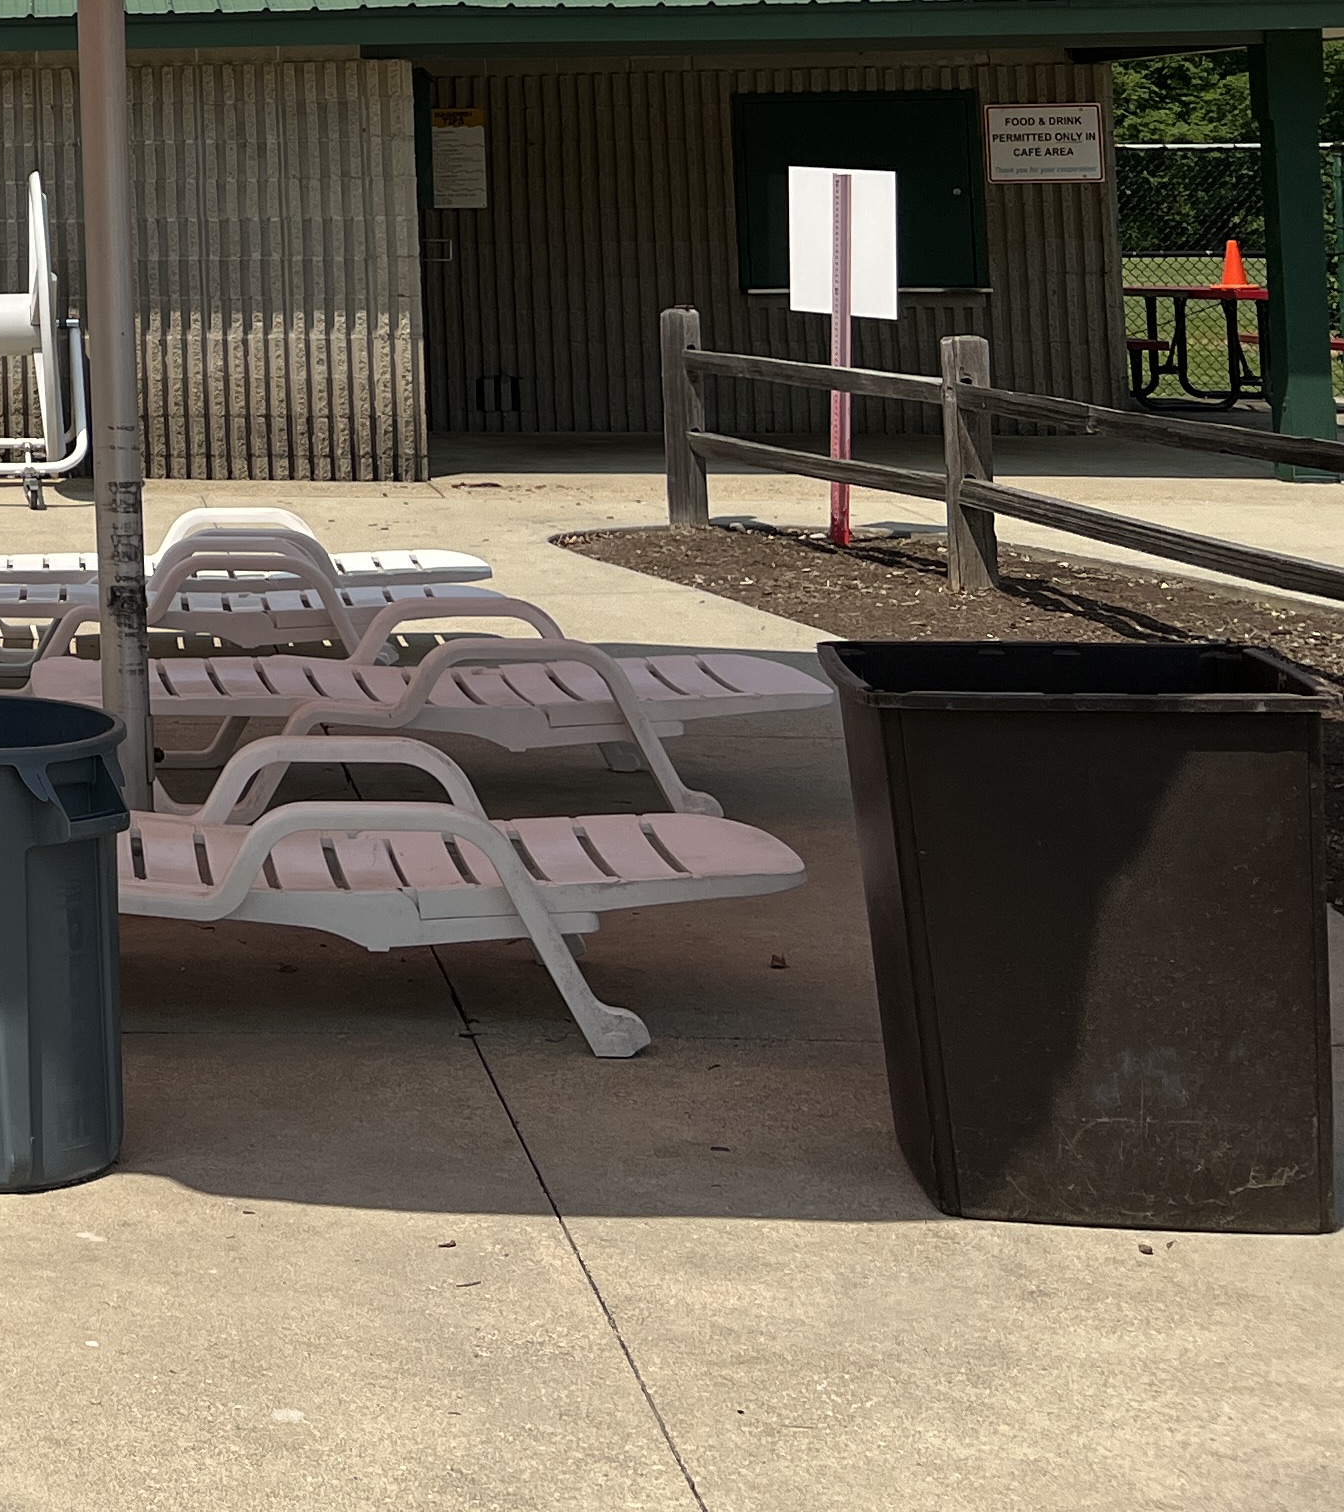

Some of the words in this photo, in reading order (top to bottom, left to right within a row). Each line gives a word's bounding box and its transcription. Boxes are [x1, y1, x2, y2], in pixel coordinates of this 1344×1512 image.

[1004, 117, 1036, 127] FOOD
[1038, 117, 1046, 126] &
[1049, 116, 1082, 125] DRINK
[992, 133, 1053, 143] PERMITTED
[1055, 132, 1083, 142] ONLY
[1086, 132, 1096, 141] IN
[1044, 147, 1074, 157] AREA
